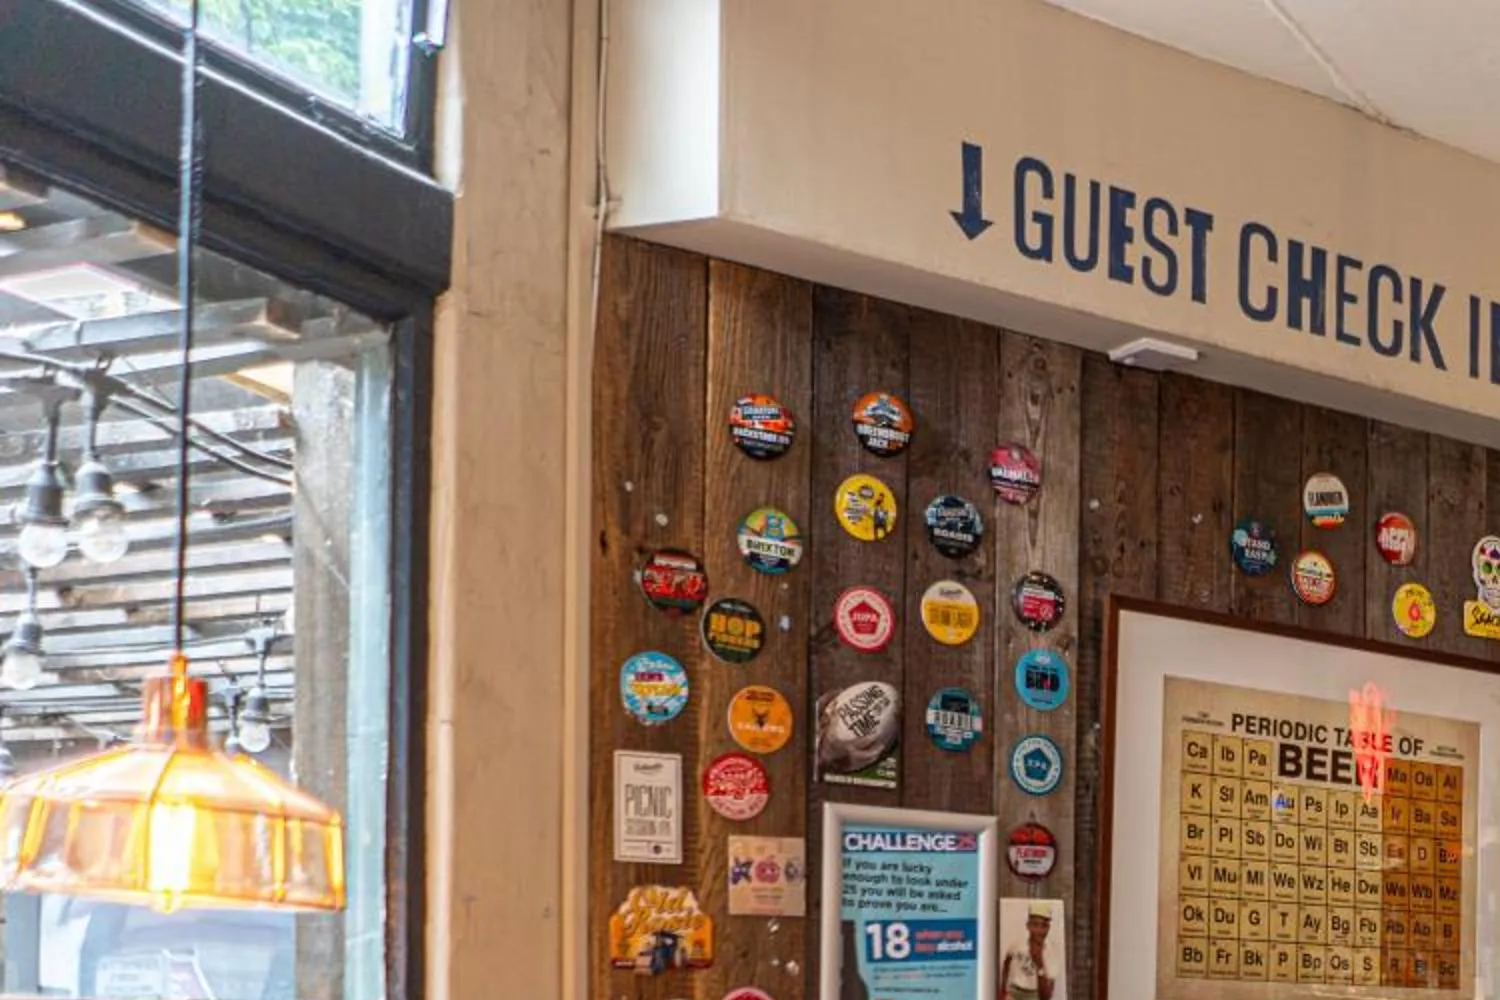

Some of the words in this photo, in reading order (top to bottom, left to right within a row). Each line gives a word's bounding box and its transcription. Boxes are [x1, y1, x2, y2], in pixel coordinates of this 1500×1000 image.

[1013, 156, 1214, 304] GUEST
[1238, 221, 1448, 372] CHECK
[709, 613, 760, 637] HOP
[1231, 713, 1328, 744] PERIODIC
[1334, 727, 1393, 752] TABLE
[1399, 737, 1424, 757] OF
[1187, 742, 1208, 759] Ca
[1249, 751, 1266, 766] Pa
[1191, 784, 1202, 799] K
[1245, 789, 1268, 806] Am
[624, 783, 673, 820] PICNIC
[1305, 796, 1323, 813] Ps
[1187, 824, 1204, 839] Br
[1245, 830, 1265, 846] Sb
[1275, 833, 1295, 849] Do
[902, 860, 932, 875] lucky
[906, 874, 931, 886] look
[935, 878, 969, 889] under
[1214, 868, 1237, 884] Mu
[1302, 875, 1325, 891] Wz
[1331, 878, 1351, 892] He
[858, 900, 893, 911] prove
[1183, 905, 1204, 922] Ok
[1214, 908, 1235, 924] Du
[1248, 910, 1261, 926] G
[1279, 912, 1289, 927] T
[1331, 916, 1350, 934] Bg
[864, 922, 911, 960] 18
[1216, 949, 1232, 964] Fr
[1278, 952, 1289, 967] P
[1363, 956, 1373, 971] S
